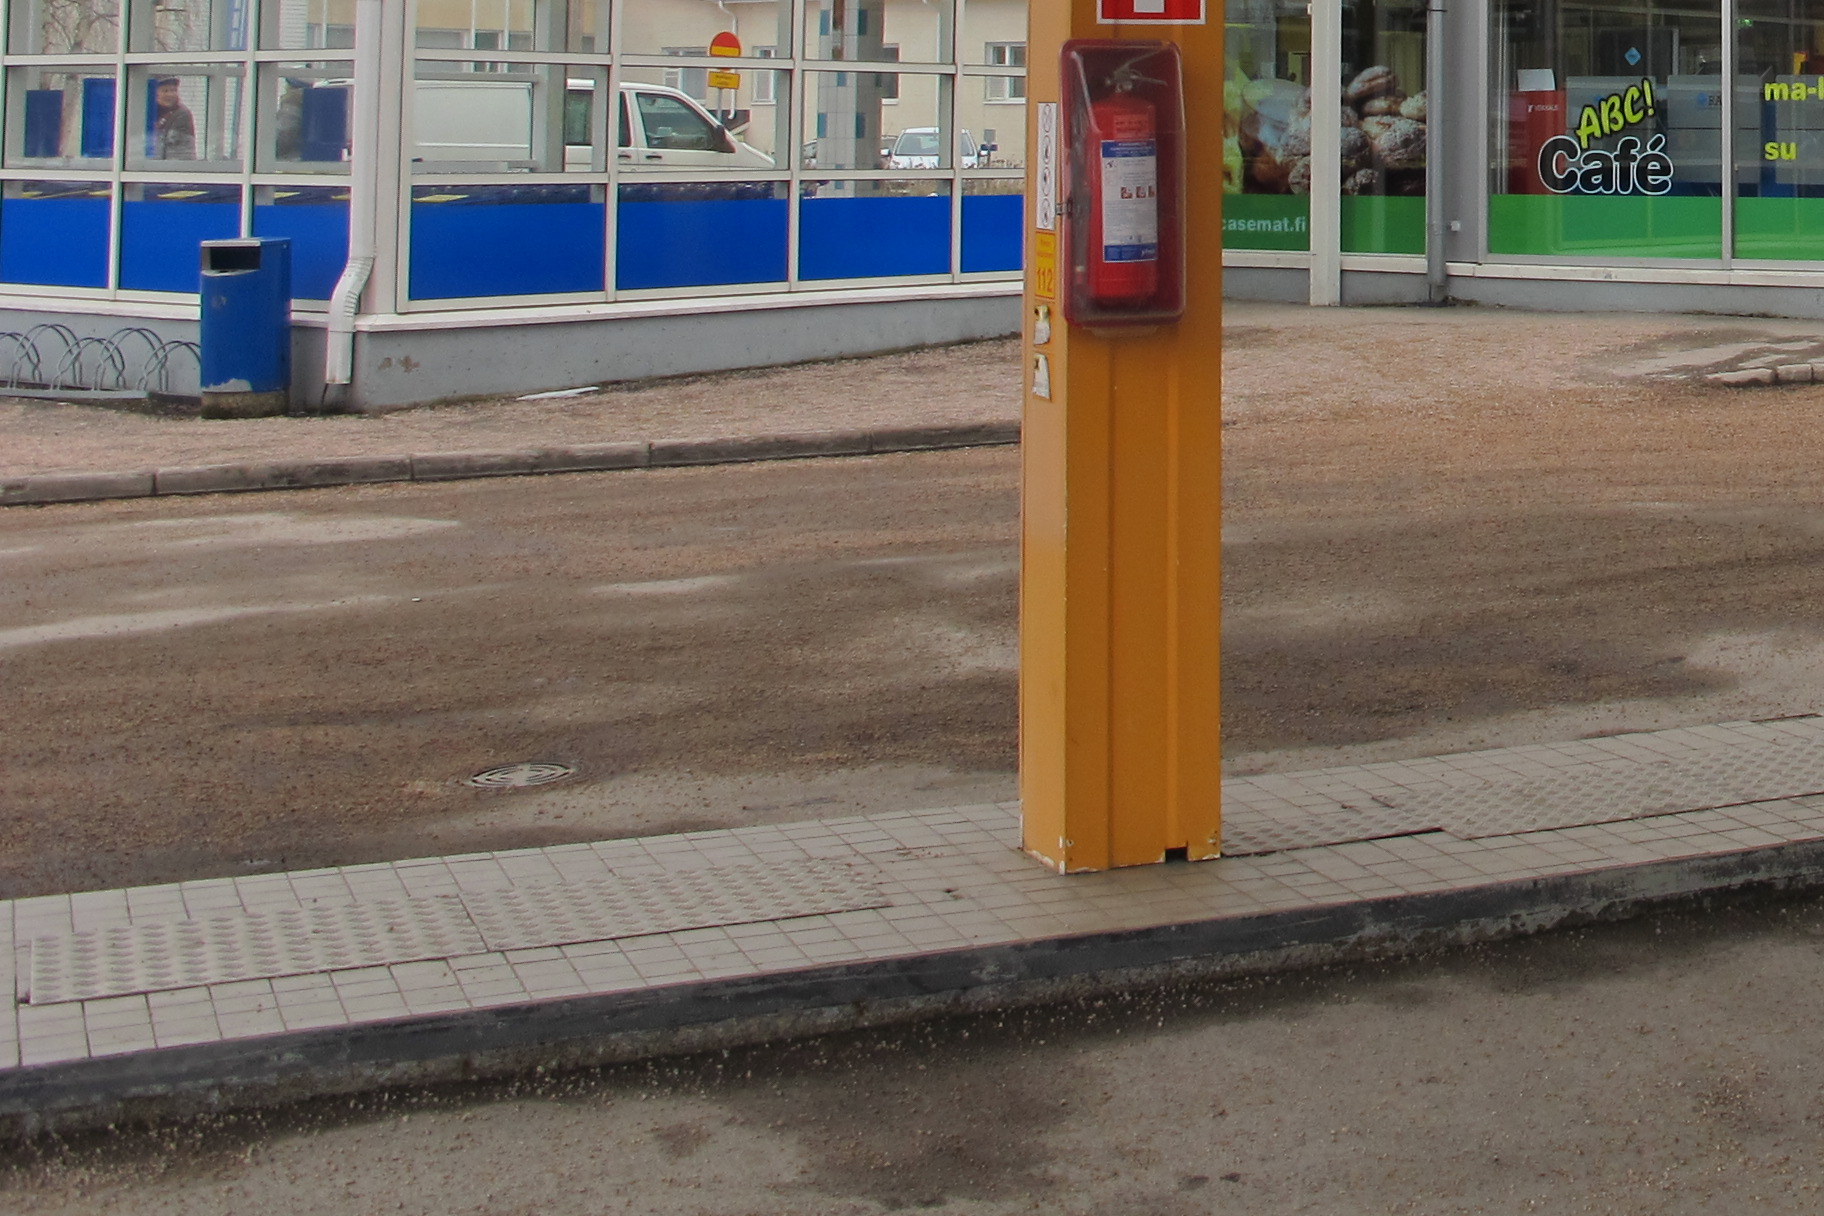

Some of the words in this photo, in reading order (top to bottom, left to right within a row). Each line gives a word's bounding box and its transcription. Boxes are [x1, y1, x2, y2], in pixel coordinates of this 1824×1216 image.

[1575, 79, 1655, 149] ABC!
[1538, 134, 1673, 195] Café
[1764, 141, 1797, 160] su
[1036, 268, 1053, 292] 112
